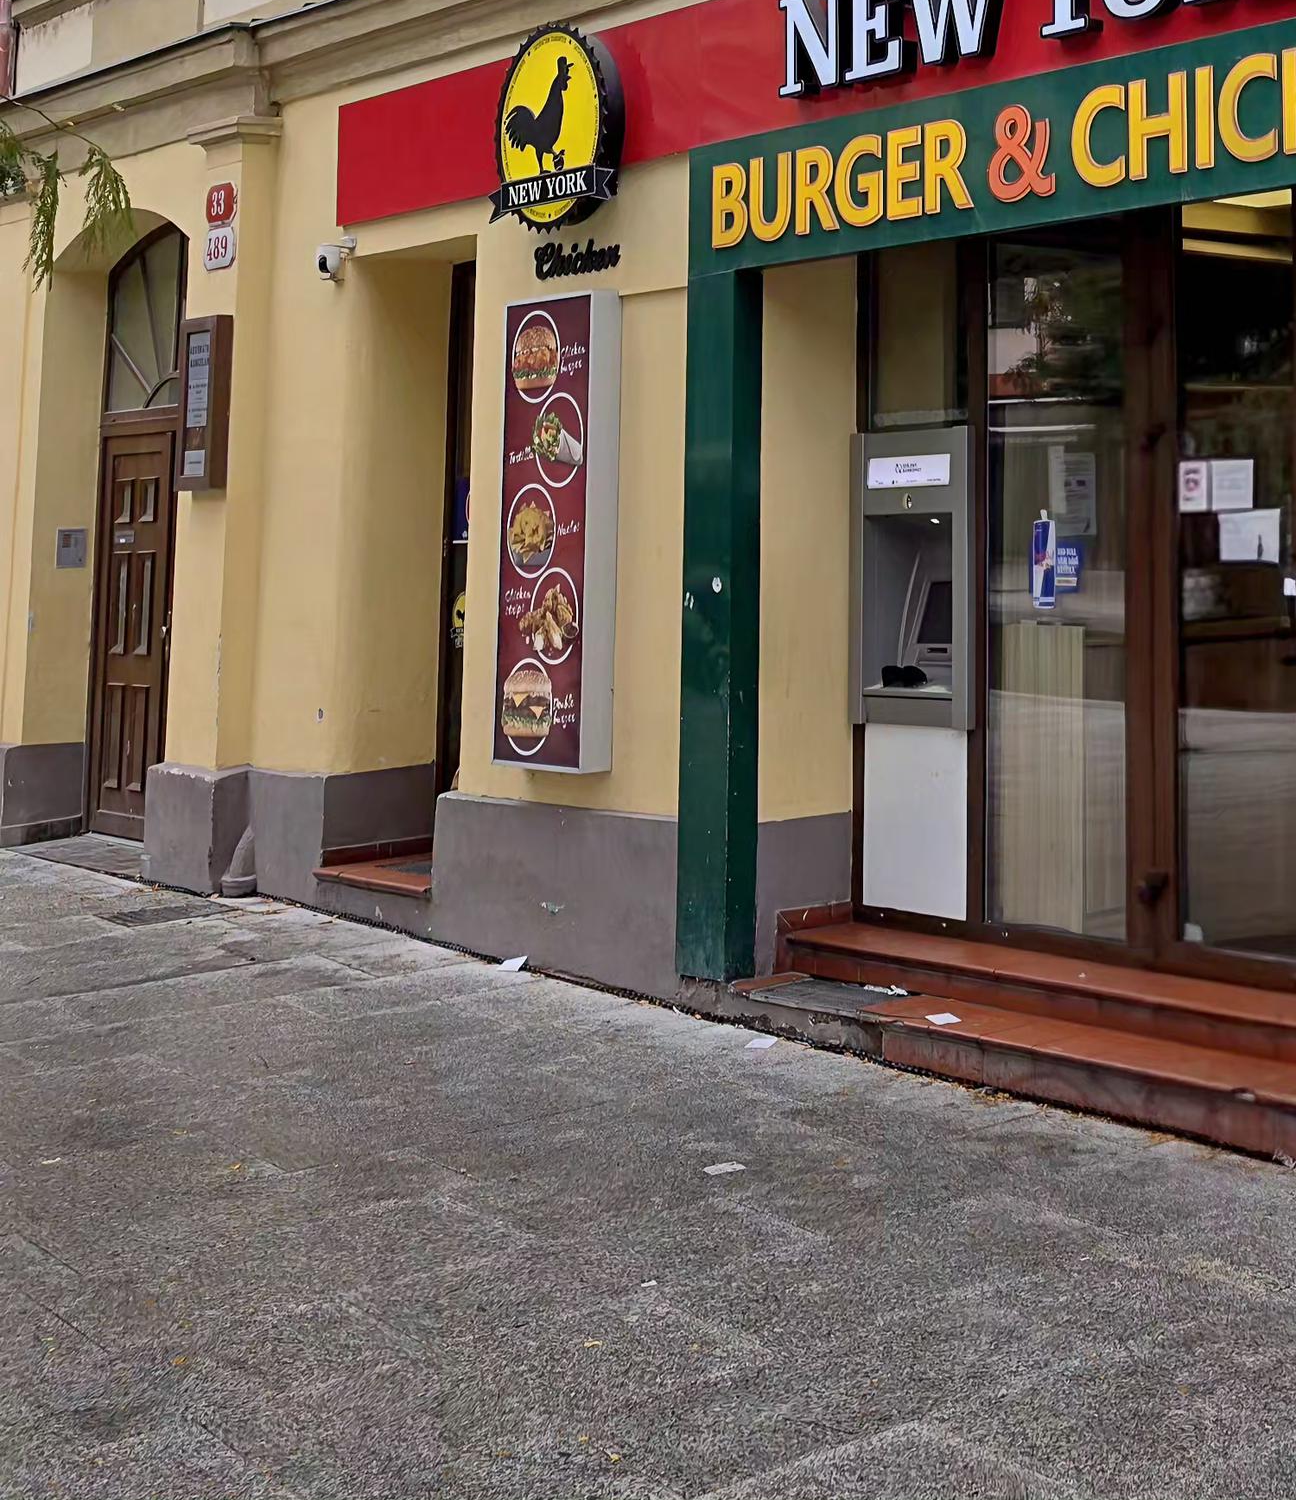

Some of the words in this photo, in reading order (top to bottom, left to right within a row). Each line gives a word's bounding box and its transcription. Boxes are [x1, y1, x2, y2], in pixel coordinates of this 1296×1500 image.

[507, 180, 542, 207] NEW
[545, 170, 588, 199] YORK
[711, 118, 975, 251] BURGER
[987, 103, 1057, 203] &
[210, 189, 225, 217] 33
[206, 235, 228, 262] 489
[533, 238, 621, 281] Chicken
